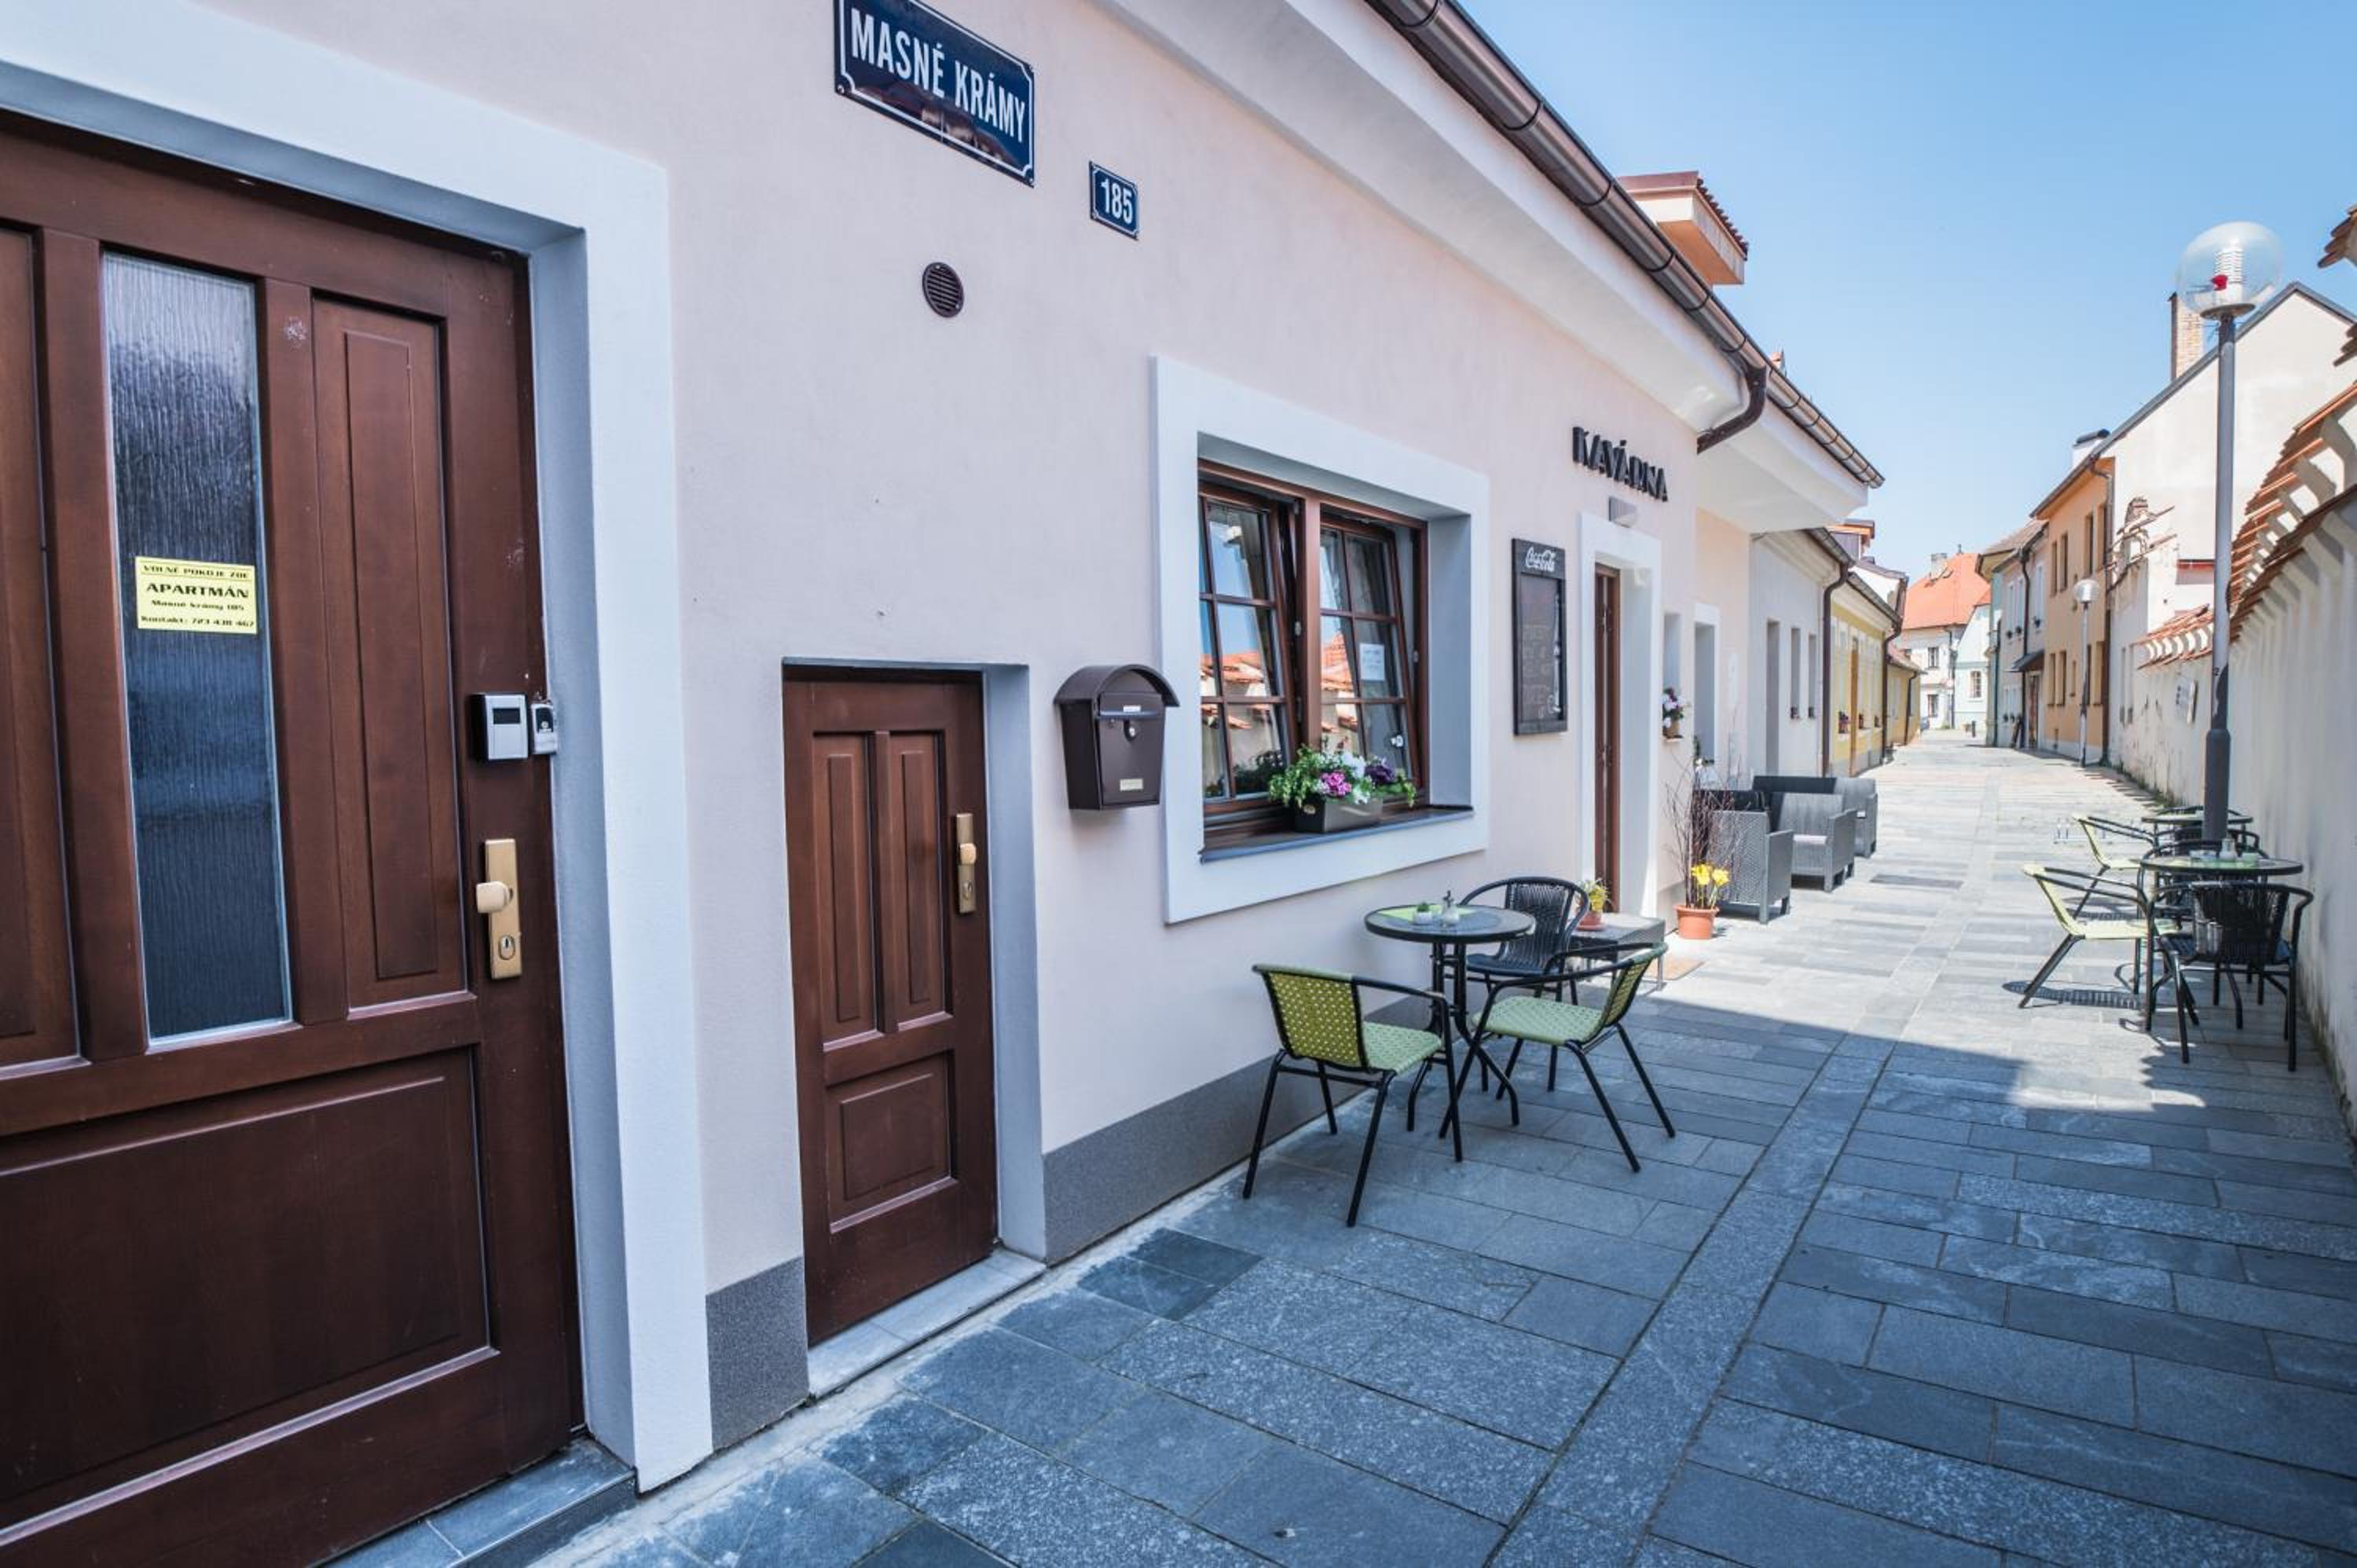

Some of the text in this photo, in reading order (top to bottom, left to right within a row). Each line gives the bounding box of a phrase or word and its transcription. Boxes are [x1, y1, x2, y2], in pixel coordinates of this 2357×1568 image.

[851, 8, 1025, 142] MASNÉ KRÁMY
[1102, 178, 1133, 224] 185
[146, 583, 249, 598] APARTMÁN
